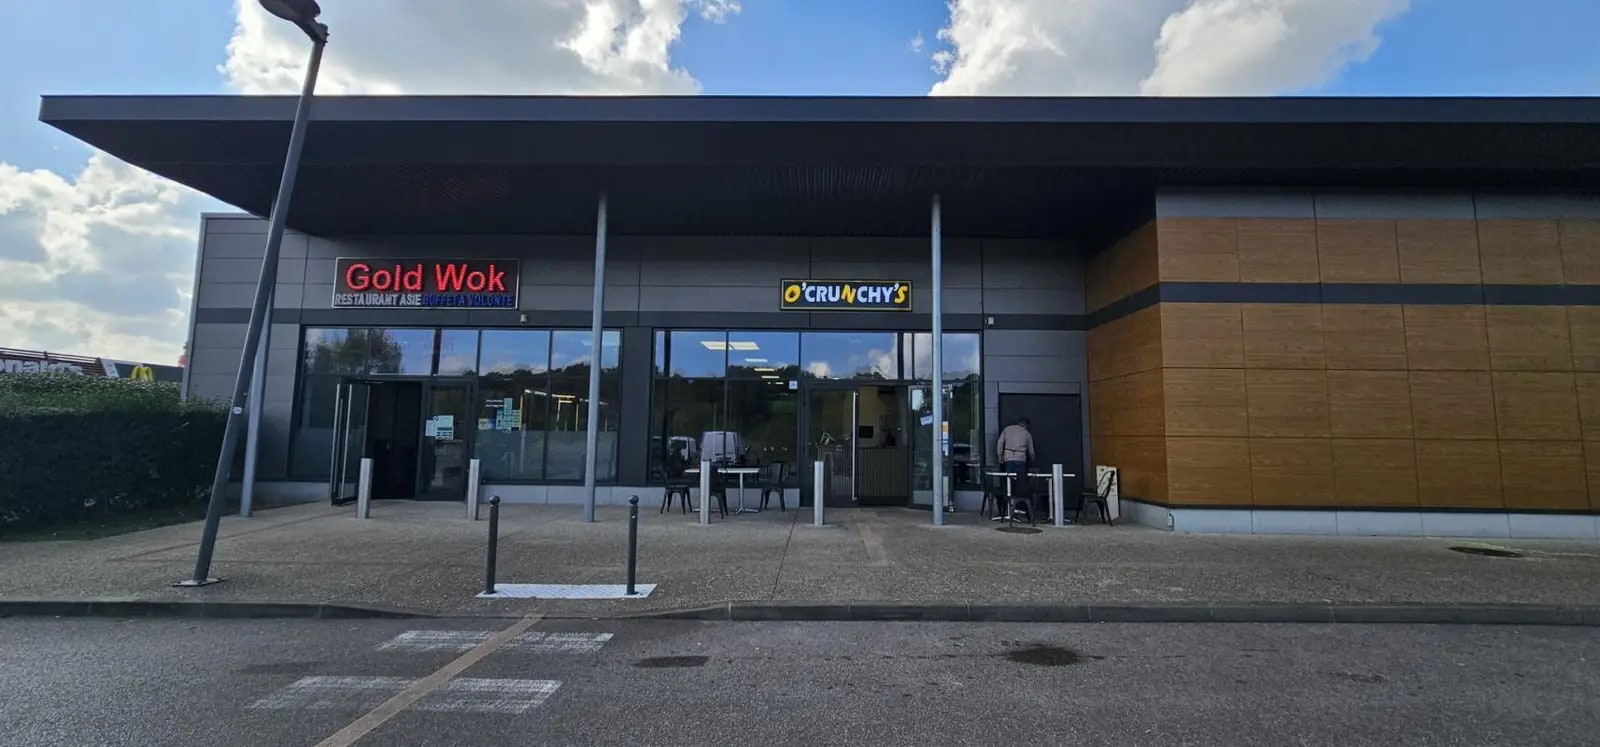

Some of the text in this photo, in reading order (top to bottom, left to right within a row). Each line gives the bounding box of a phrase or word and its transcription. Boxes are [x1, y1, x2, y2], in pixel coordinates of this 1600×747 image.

[345, 263, 506, 292] Gold Wok
[334, 293, 399, 306] RESTAURANT
[399, 293, 422, 306] ASIE
[422, 294, 457, 306] BUFFET
[784, 281, 909, 304] O'CRUNCHY'S
